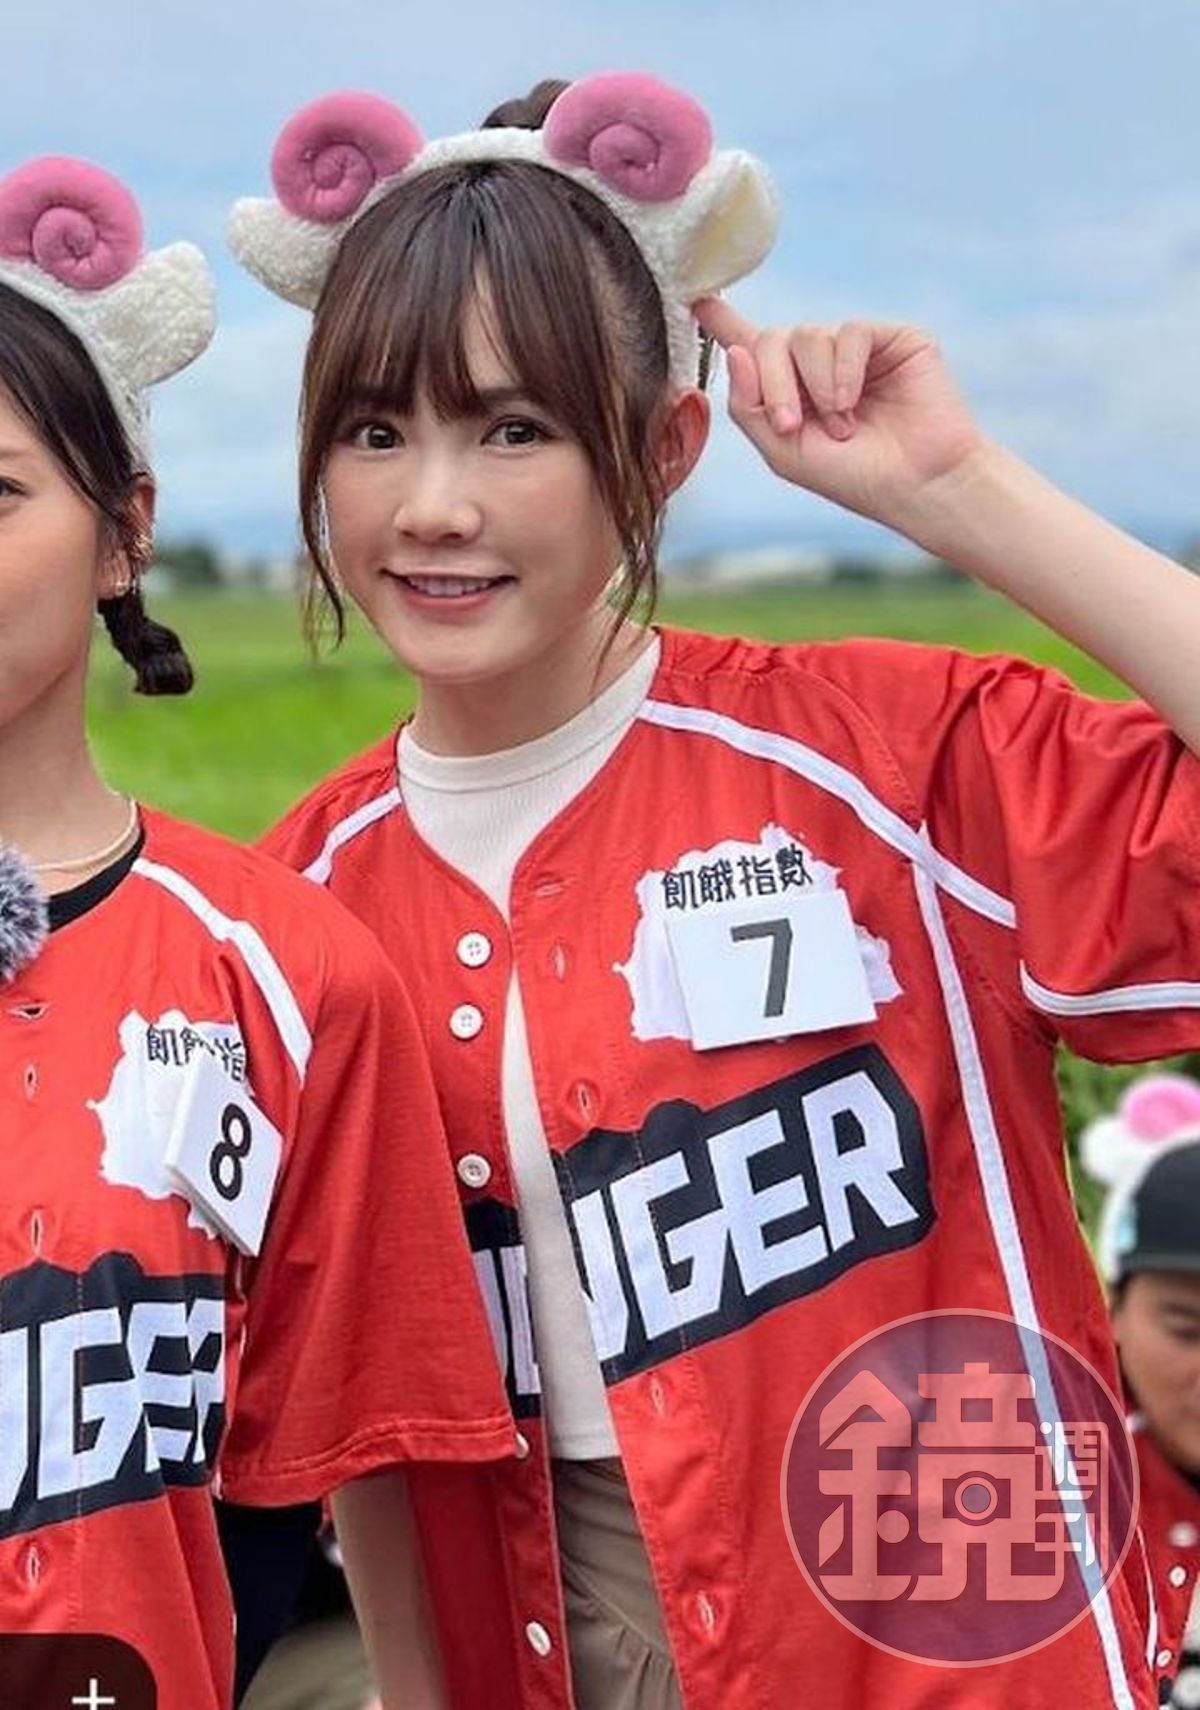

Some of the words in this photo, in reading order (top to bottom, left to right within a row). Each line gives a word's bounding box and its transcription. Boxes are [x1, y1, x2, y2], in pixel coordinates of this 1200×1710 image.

[661, 843, 813, 911] 飢餓指數
[729, 918, 793, 1018] 7
[210, 1103, 251, 1201] 8
